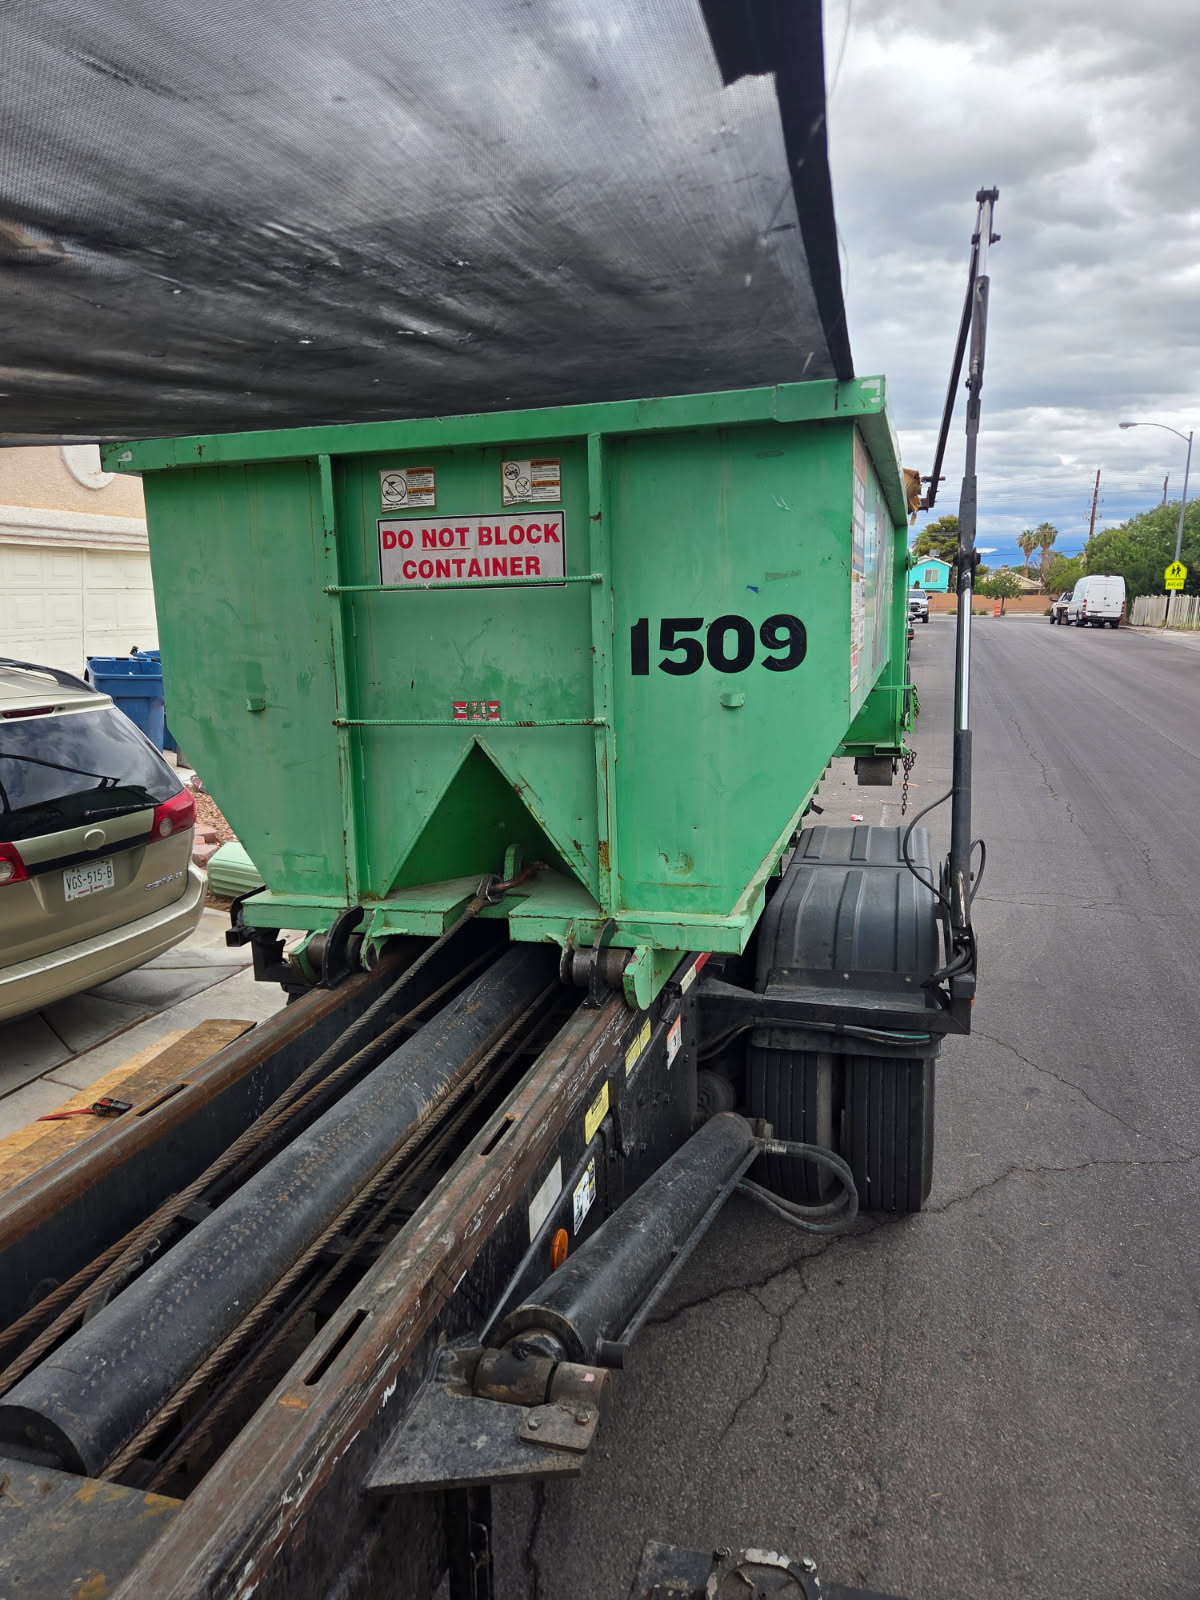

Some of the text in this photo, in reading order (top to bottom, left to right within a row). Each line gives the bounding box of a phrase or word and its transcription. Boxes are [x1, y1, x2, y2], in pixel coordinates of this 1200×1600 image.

[382, 523, 561, 550] DO NOT BLOCK
[402, 556, 541, 580] CONTAINER
[631, 613, 807, 676] 1509
[66, 866, 112, 891] VGS-515-B
